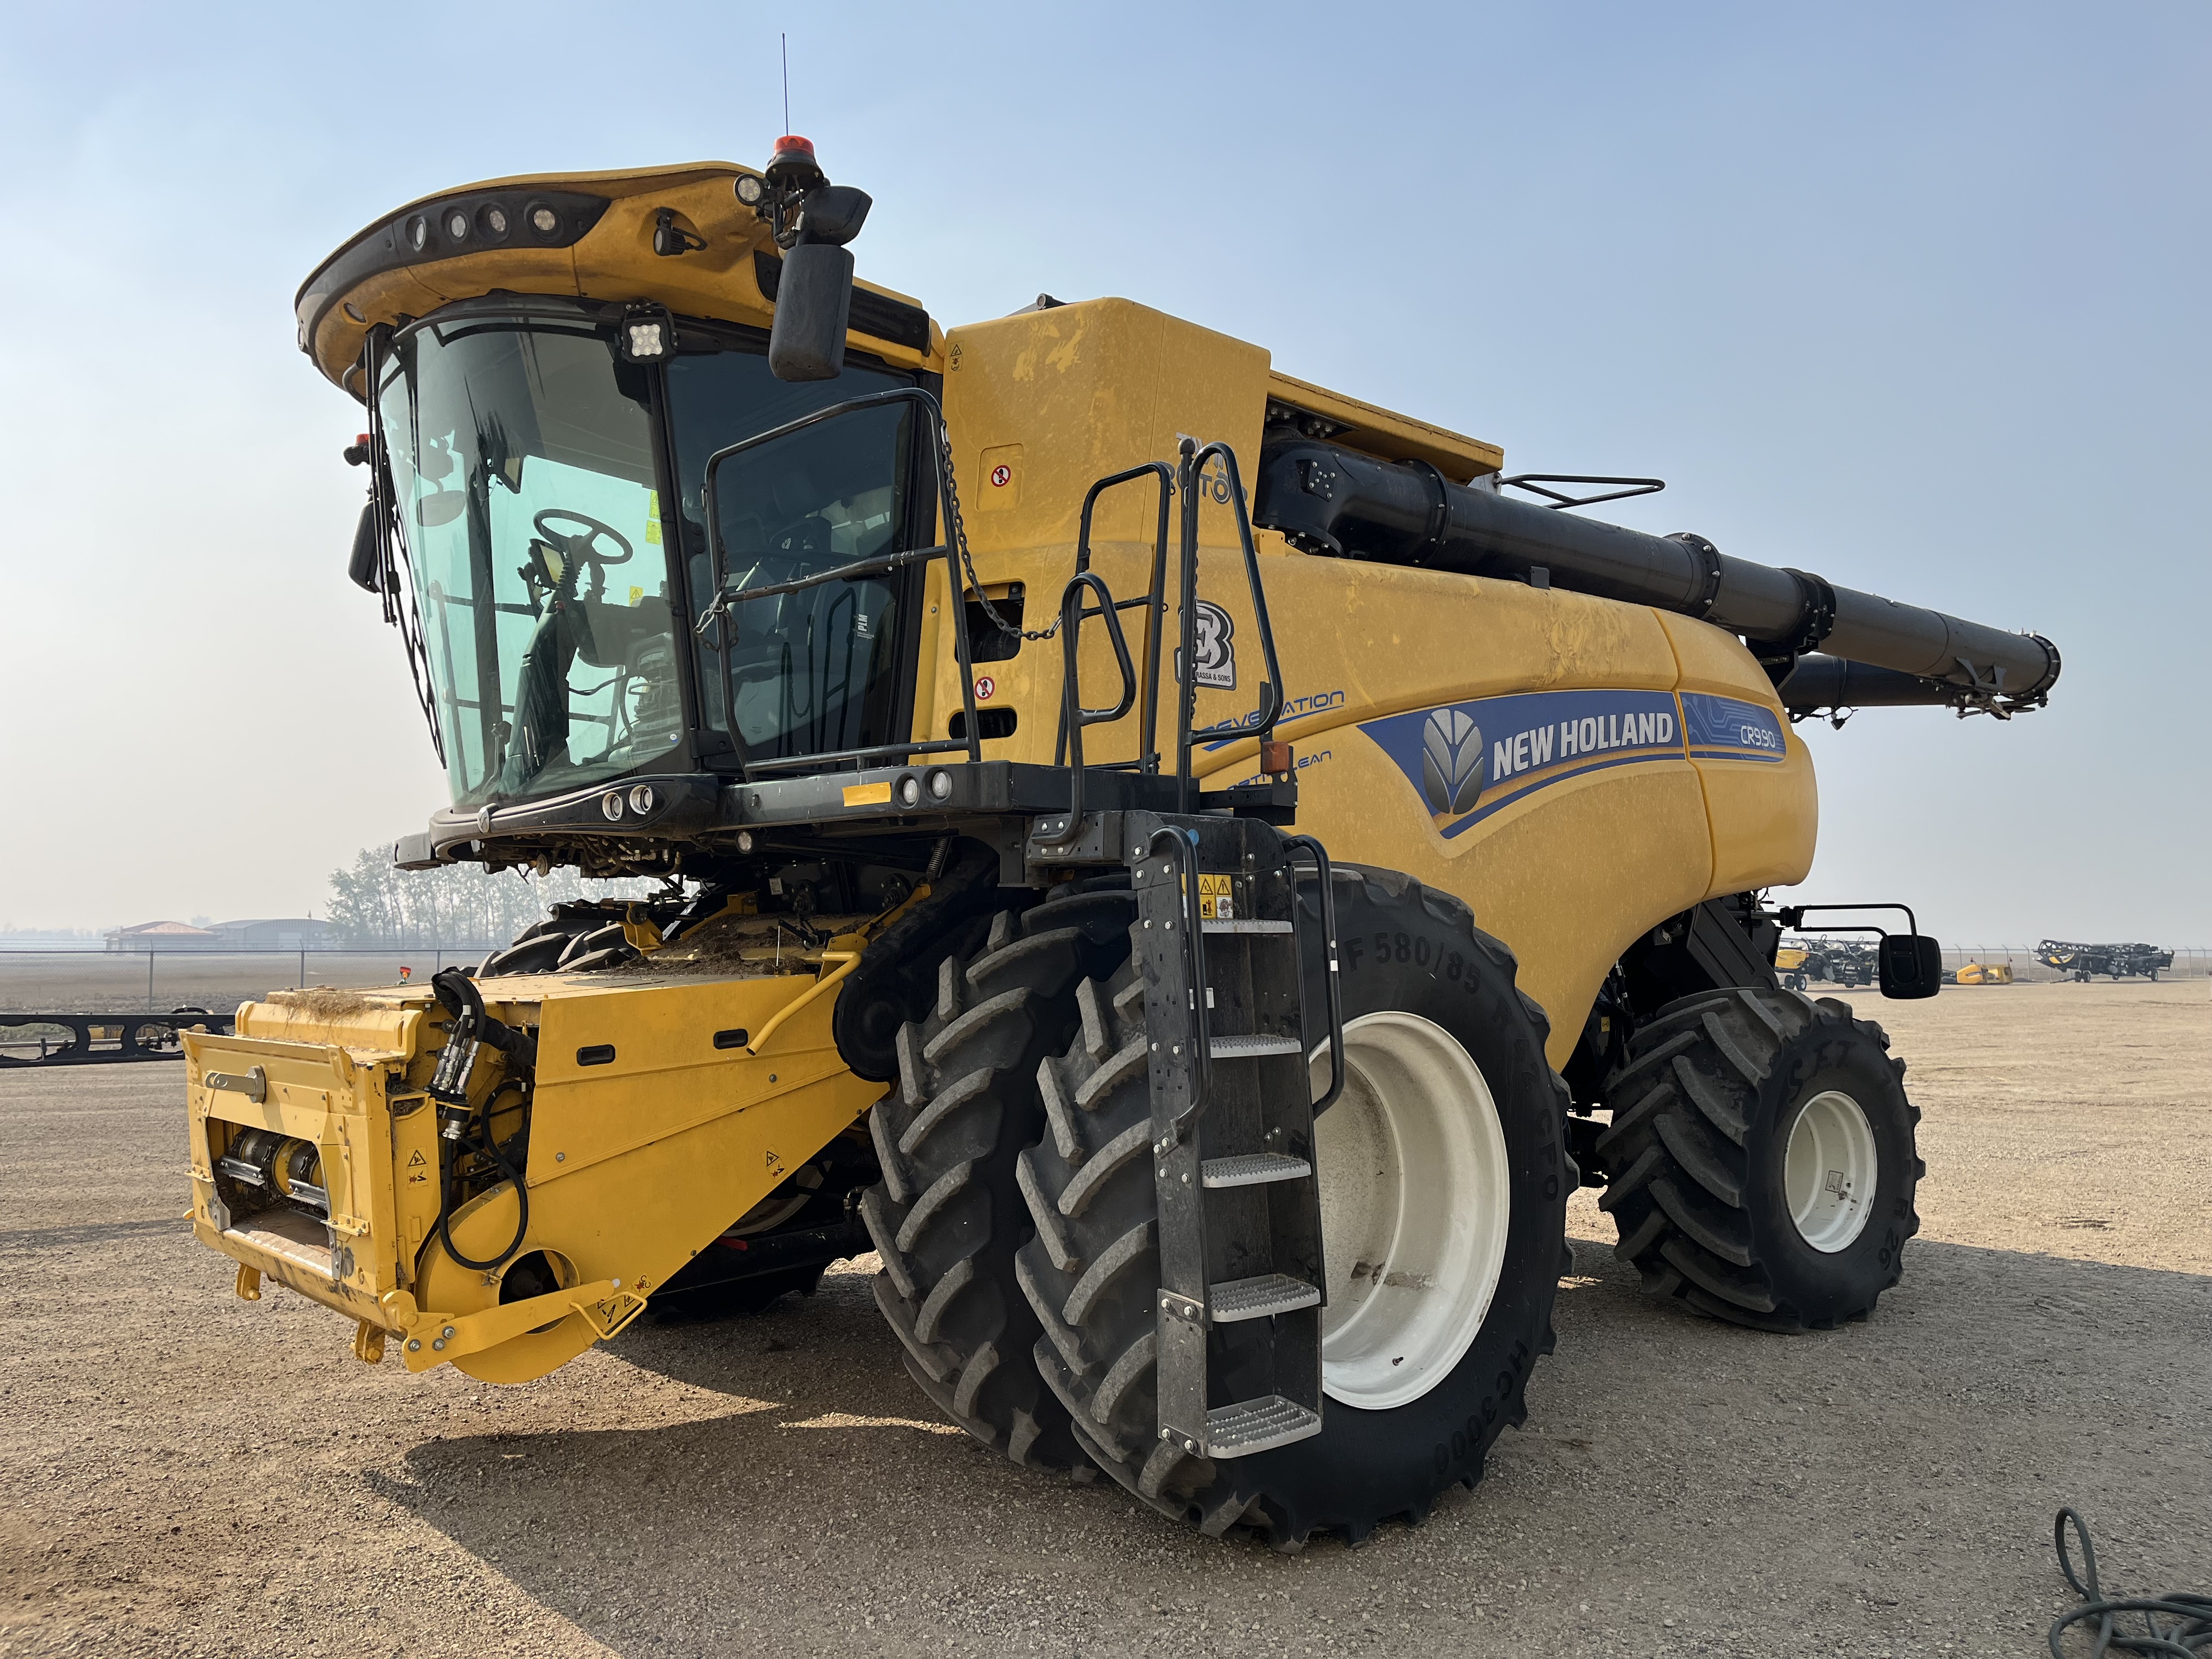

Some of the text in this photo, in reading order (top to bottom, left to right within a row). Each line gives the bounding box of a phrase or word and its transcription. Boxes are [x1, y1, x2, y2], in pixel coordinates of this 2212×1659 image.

[858, 613, 868, 631] PLM
[1196, 671, 1212, 680] RASSA
[1493, 713, 1673, 781] NEW HOLLAND
[1740, 725, 1775, 748] CR9.90
[1374, 932, 1482, 995] 580/85
